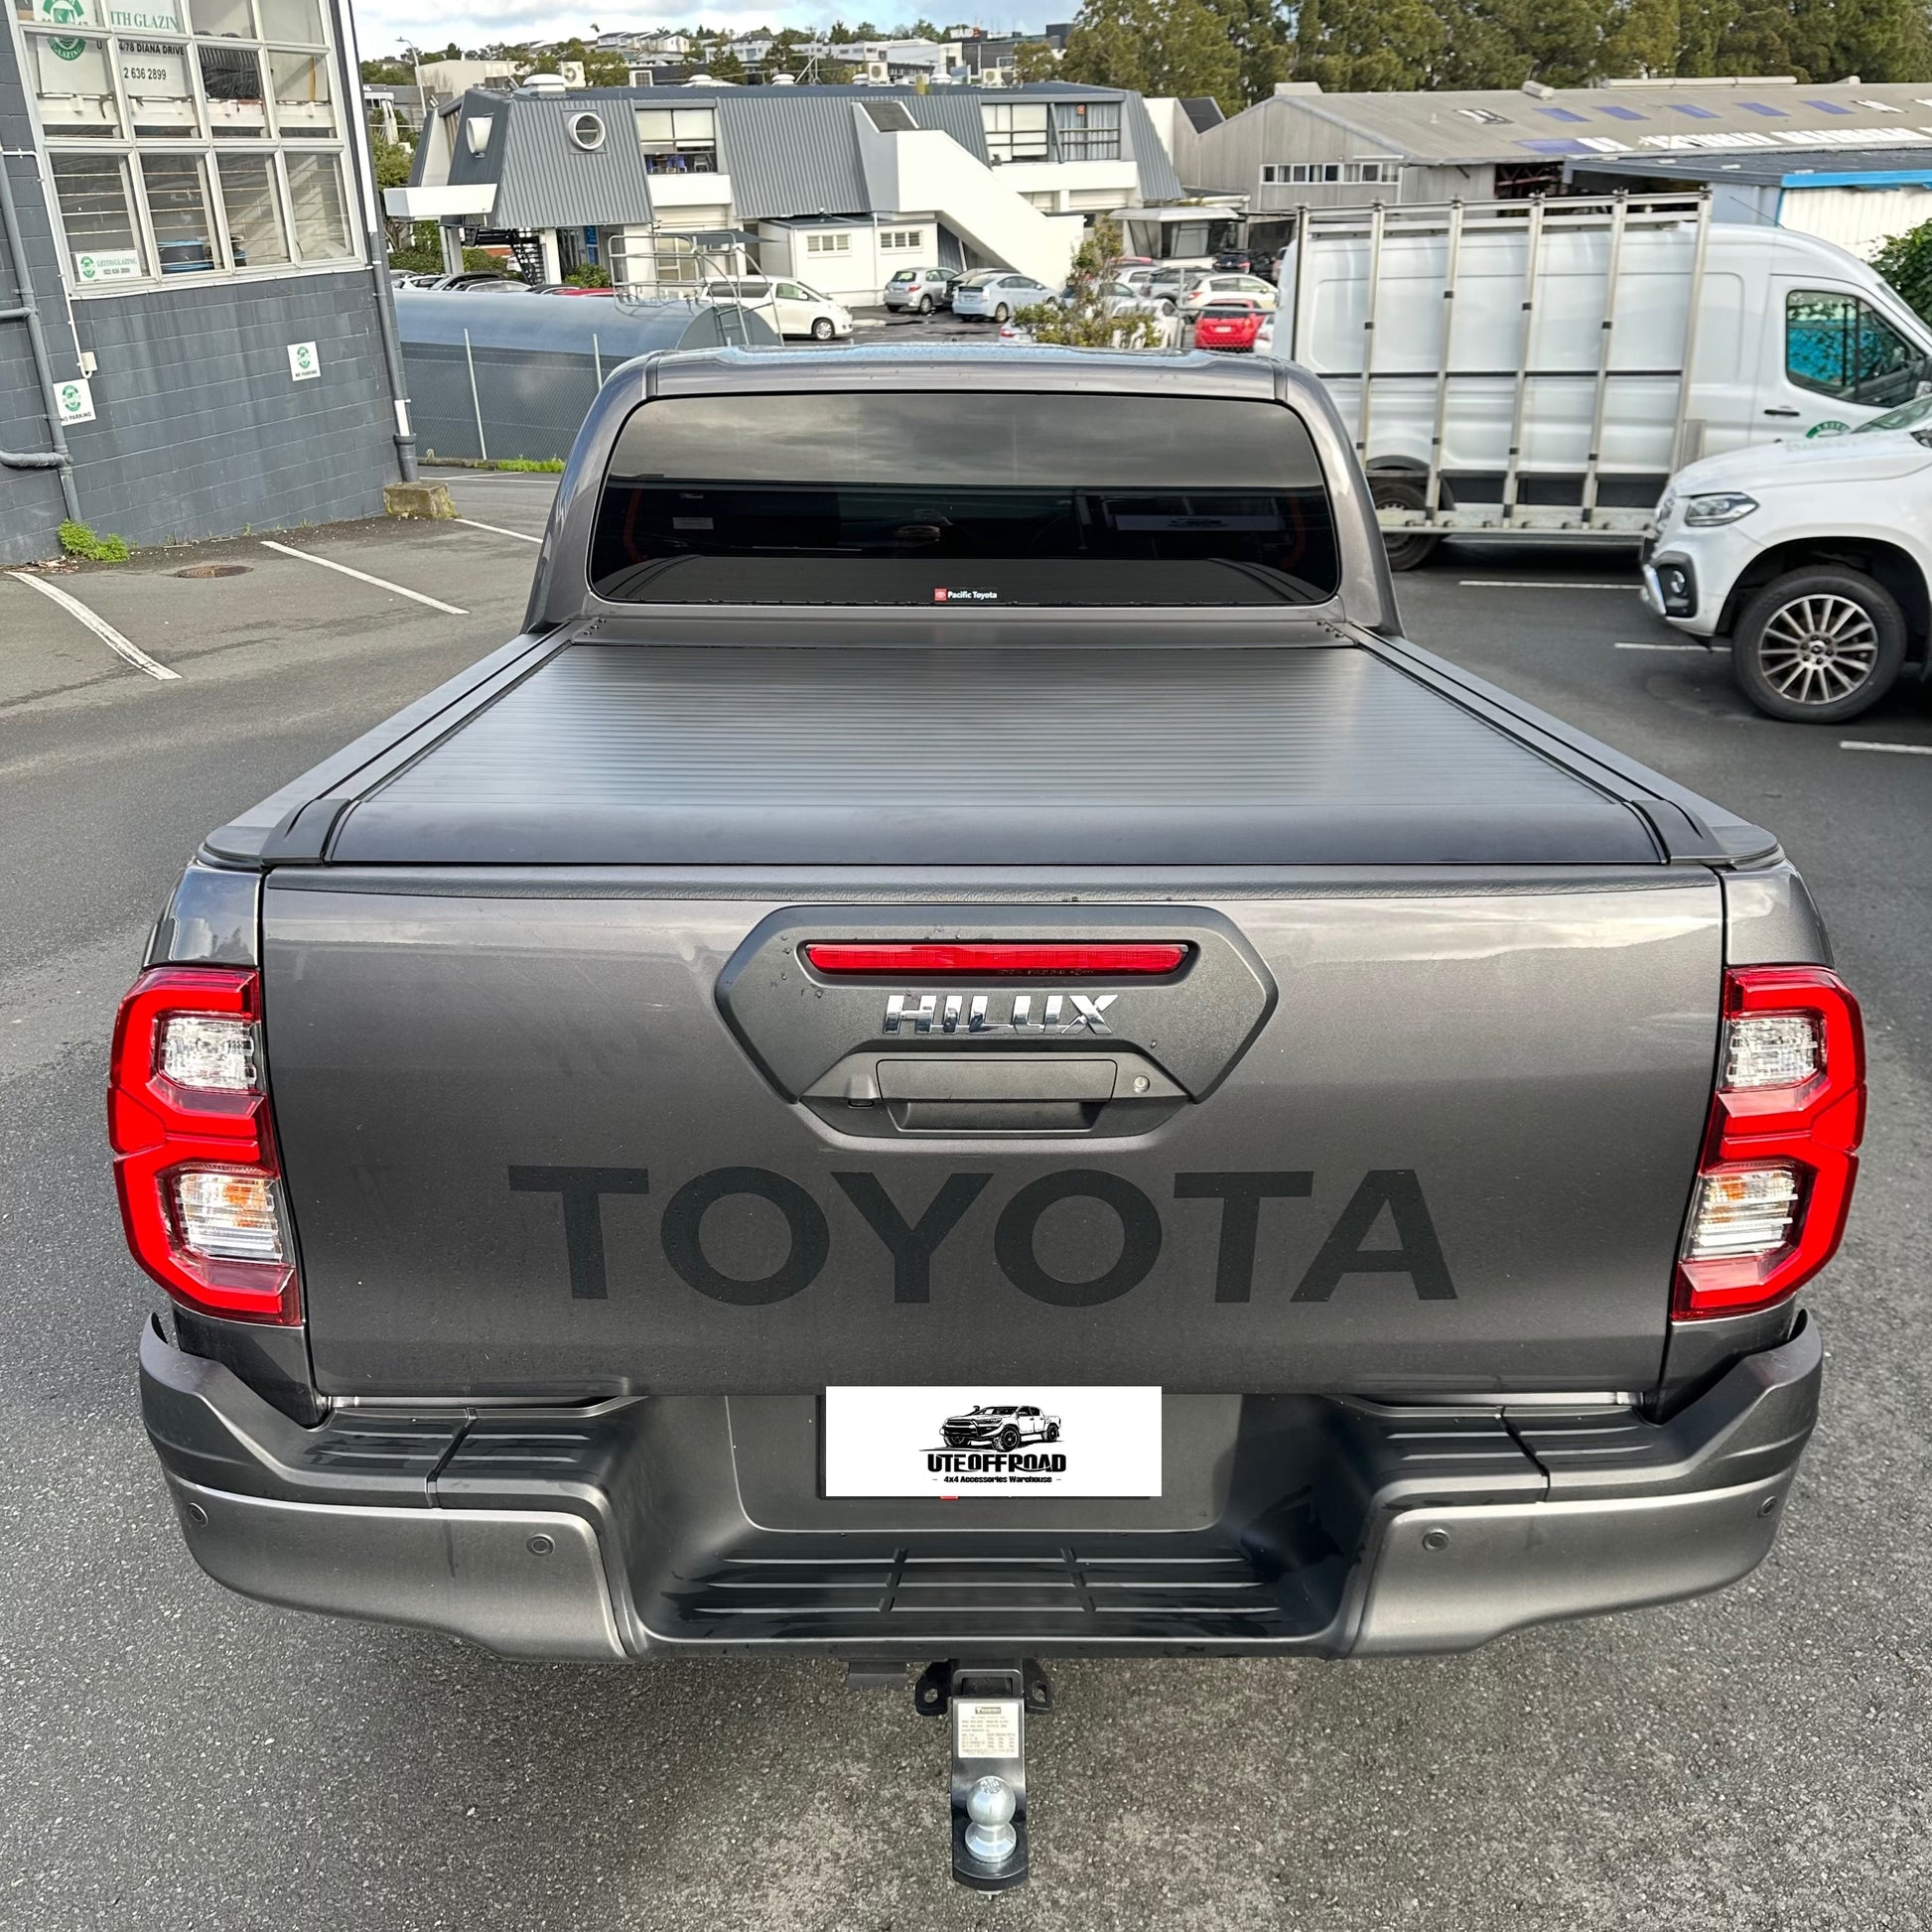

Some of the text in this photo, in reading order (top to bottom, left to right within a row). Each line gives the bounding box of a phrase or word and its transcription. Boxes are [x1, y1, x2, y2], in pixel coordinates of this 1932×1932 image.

[110, 11, 180, 31] ITH GLAZIN
[137, 44, 161, 54] DIANA
[162, 46, 185, 56] DRIVE
[131, 68, 146, 79] 636
[147, 69, 167, 80] 2899
[972, 591, 998, 600] Toyota
[882, 994, 1119, 1035] HILUX
[508, 1165, 1458, 1308] TOYOTA
